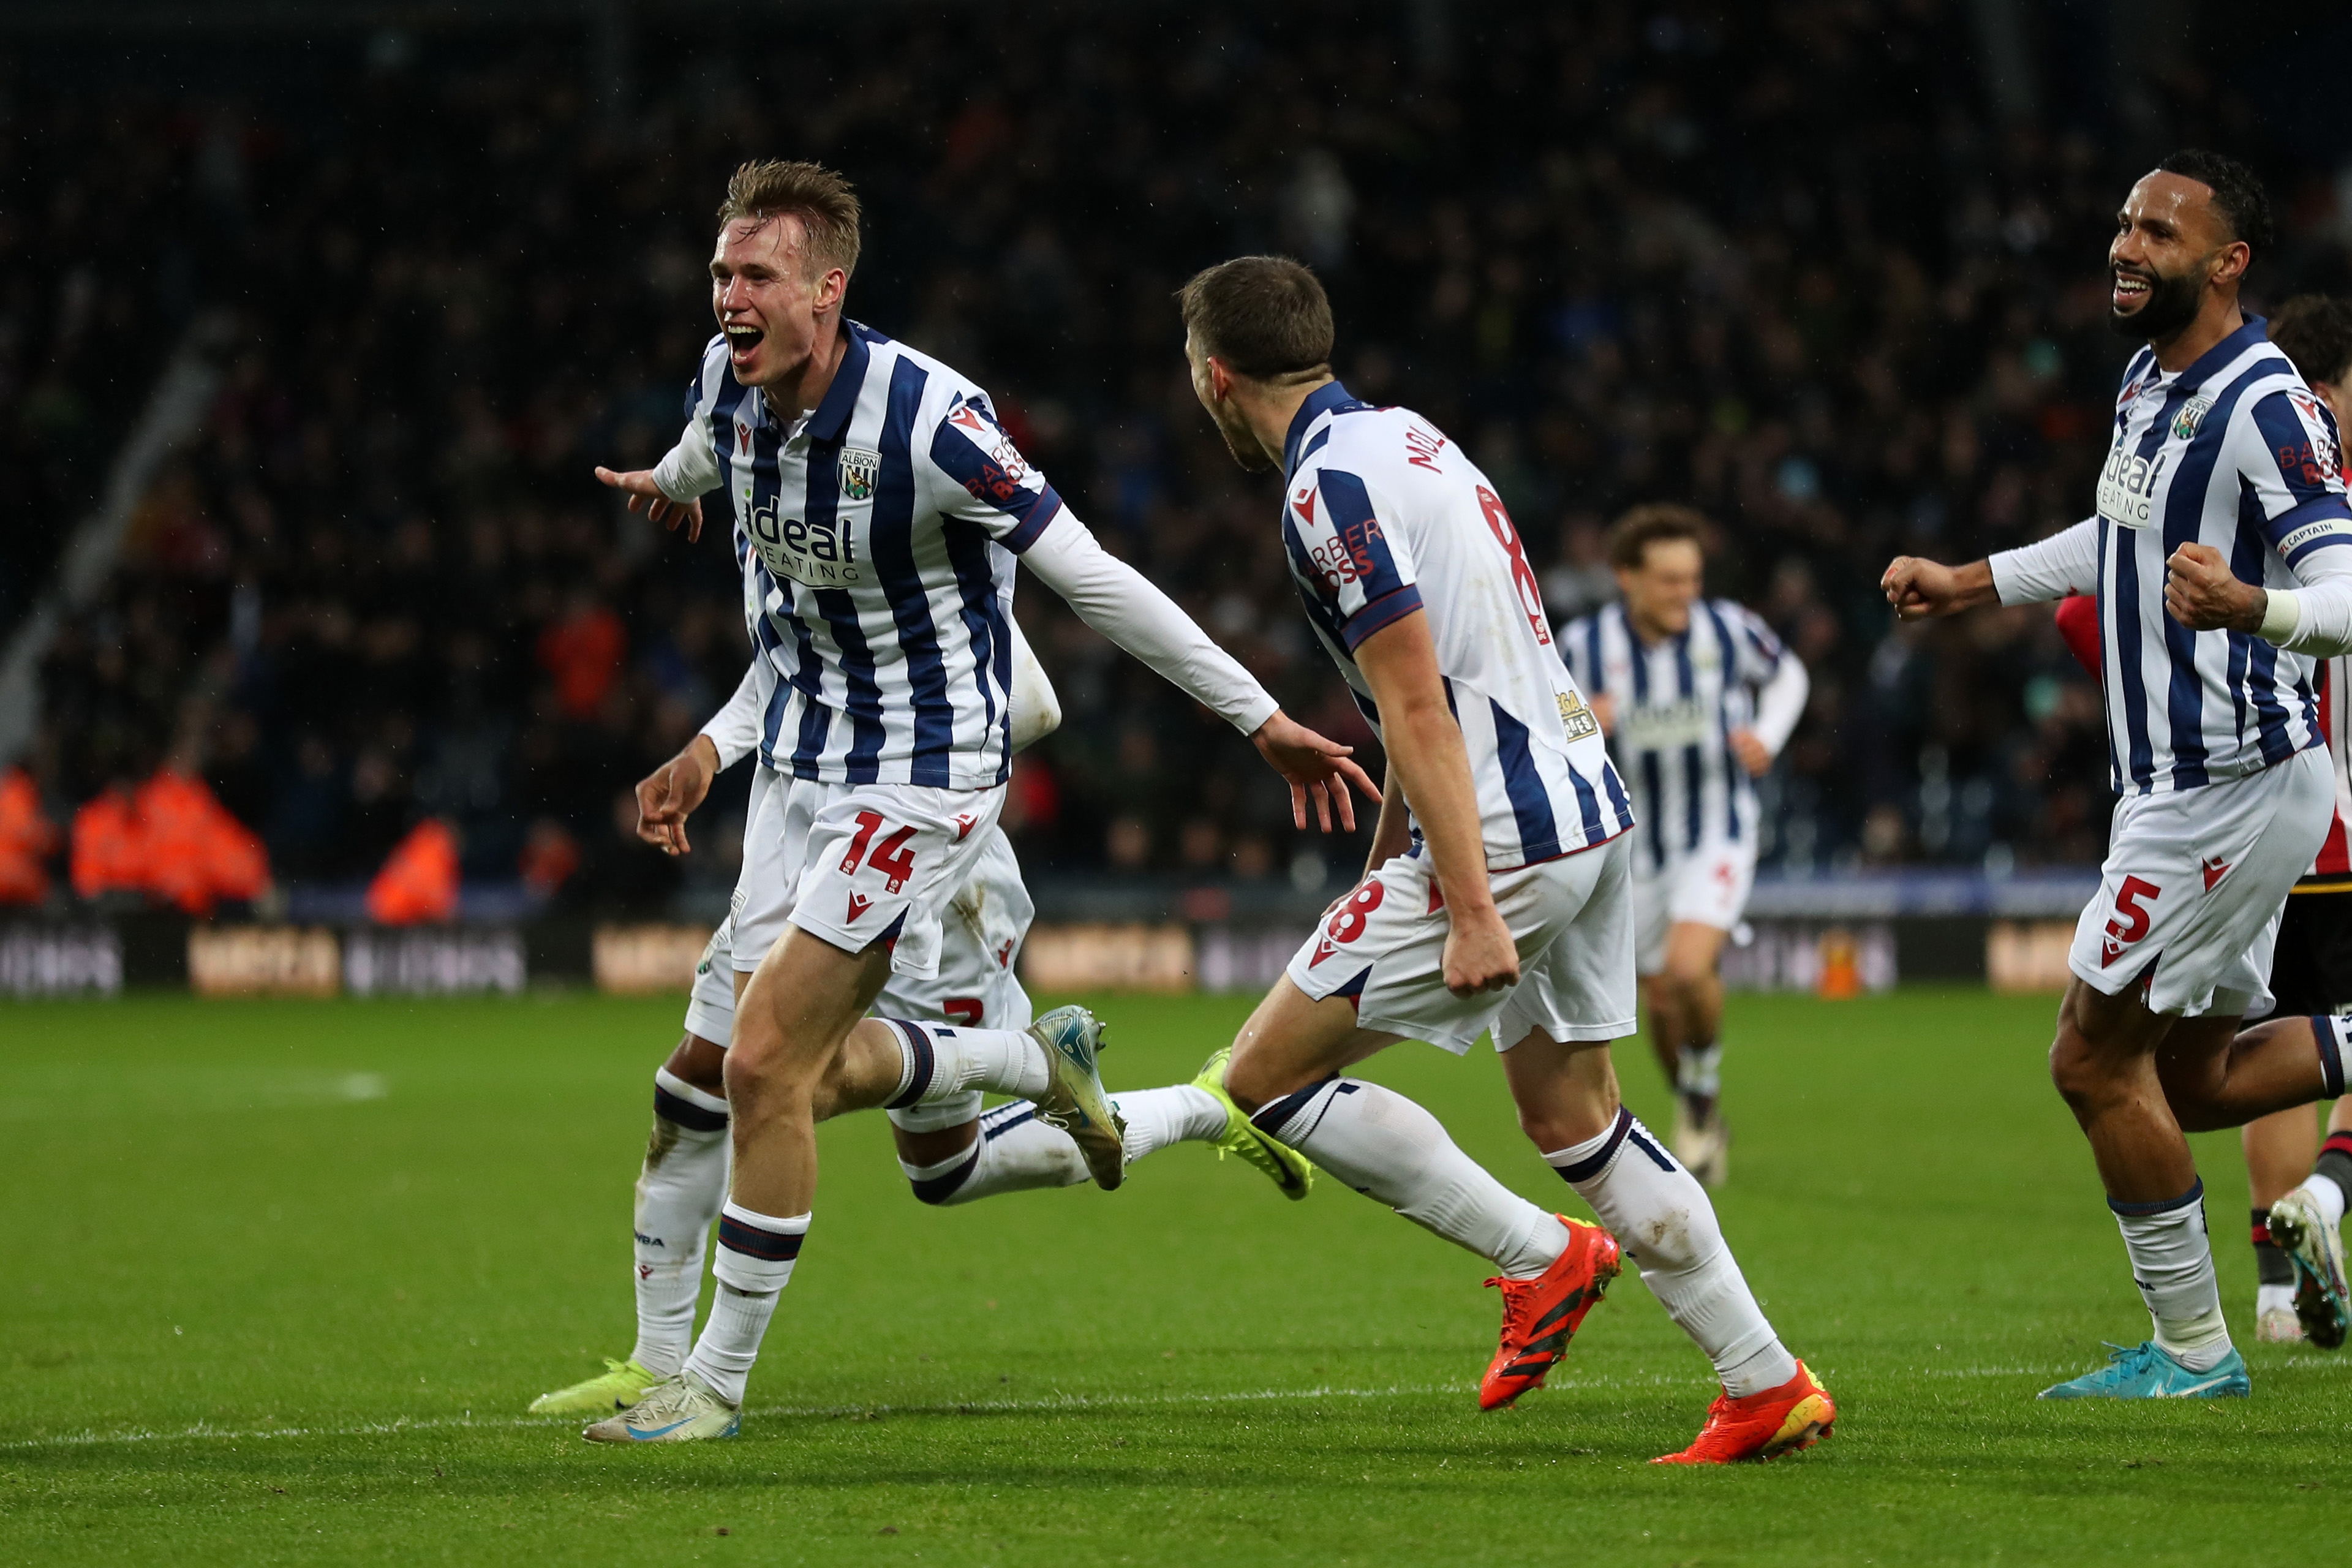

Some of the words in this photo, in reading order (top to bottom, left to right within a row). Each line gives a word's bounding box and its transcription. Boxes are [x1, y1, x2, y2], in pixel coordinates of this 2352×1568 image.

[841, 454, 877, 468] ALBION
[2102, 436, 2166, 499] deal
[745, 488, 854, 564] ideal
[2288, 522, 2333, 546] CAPTAIN
[750, 537, 859, 581] HEATING
[1475, 484, 1550, 646] 8
[839, 810, 919, 895] 14
[1328, 880, 1385, 943] 8
[2105, 874, 2162, 943] 5
